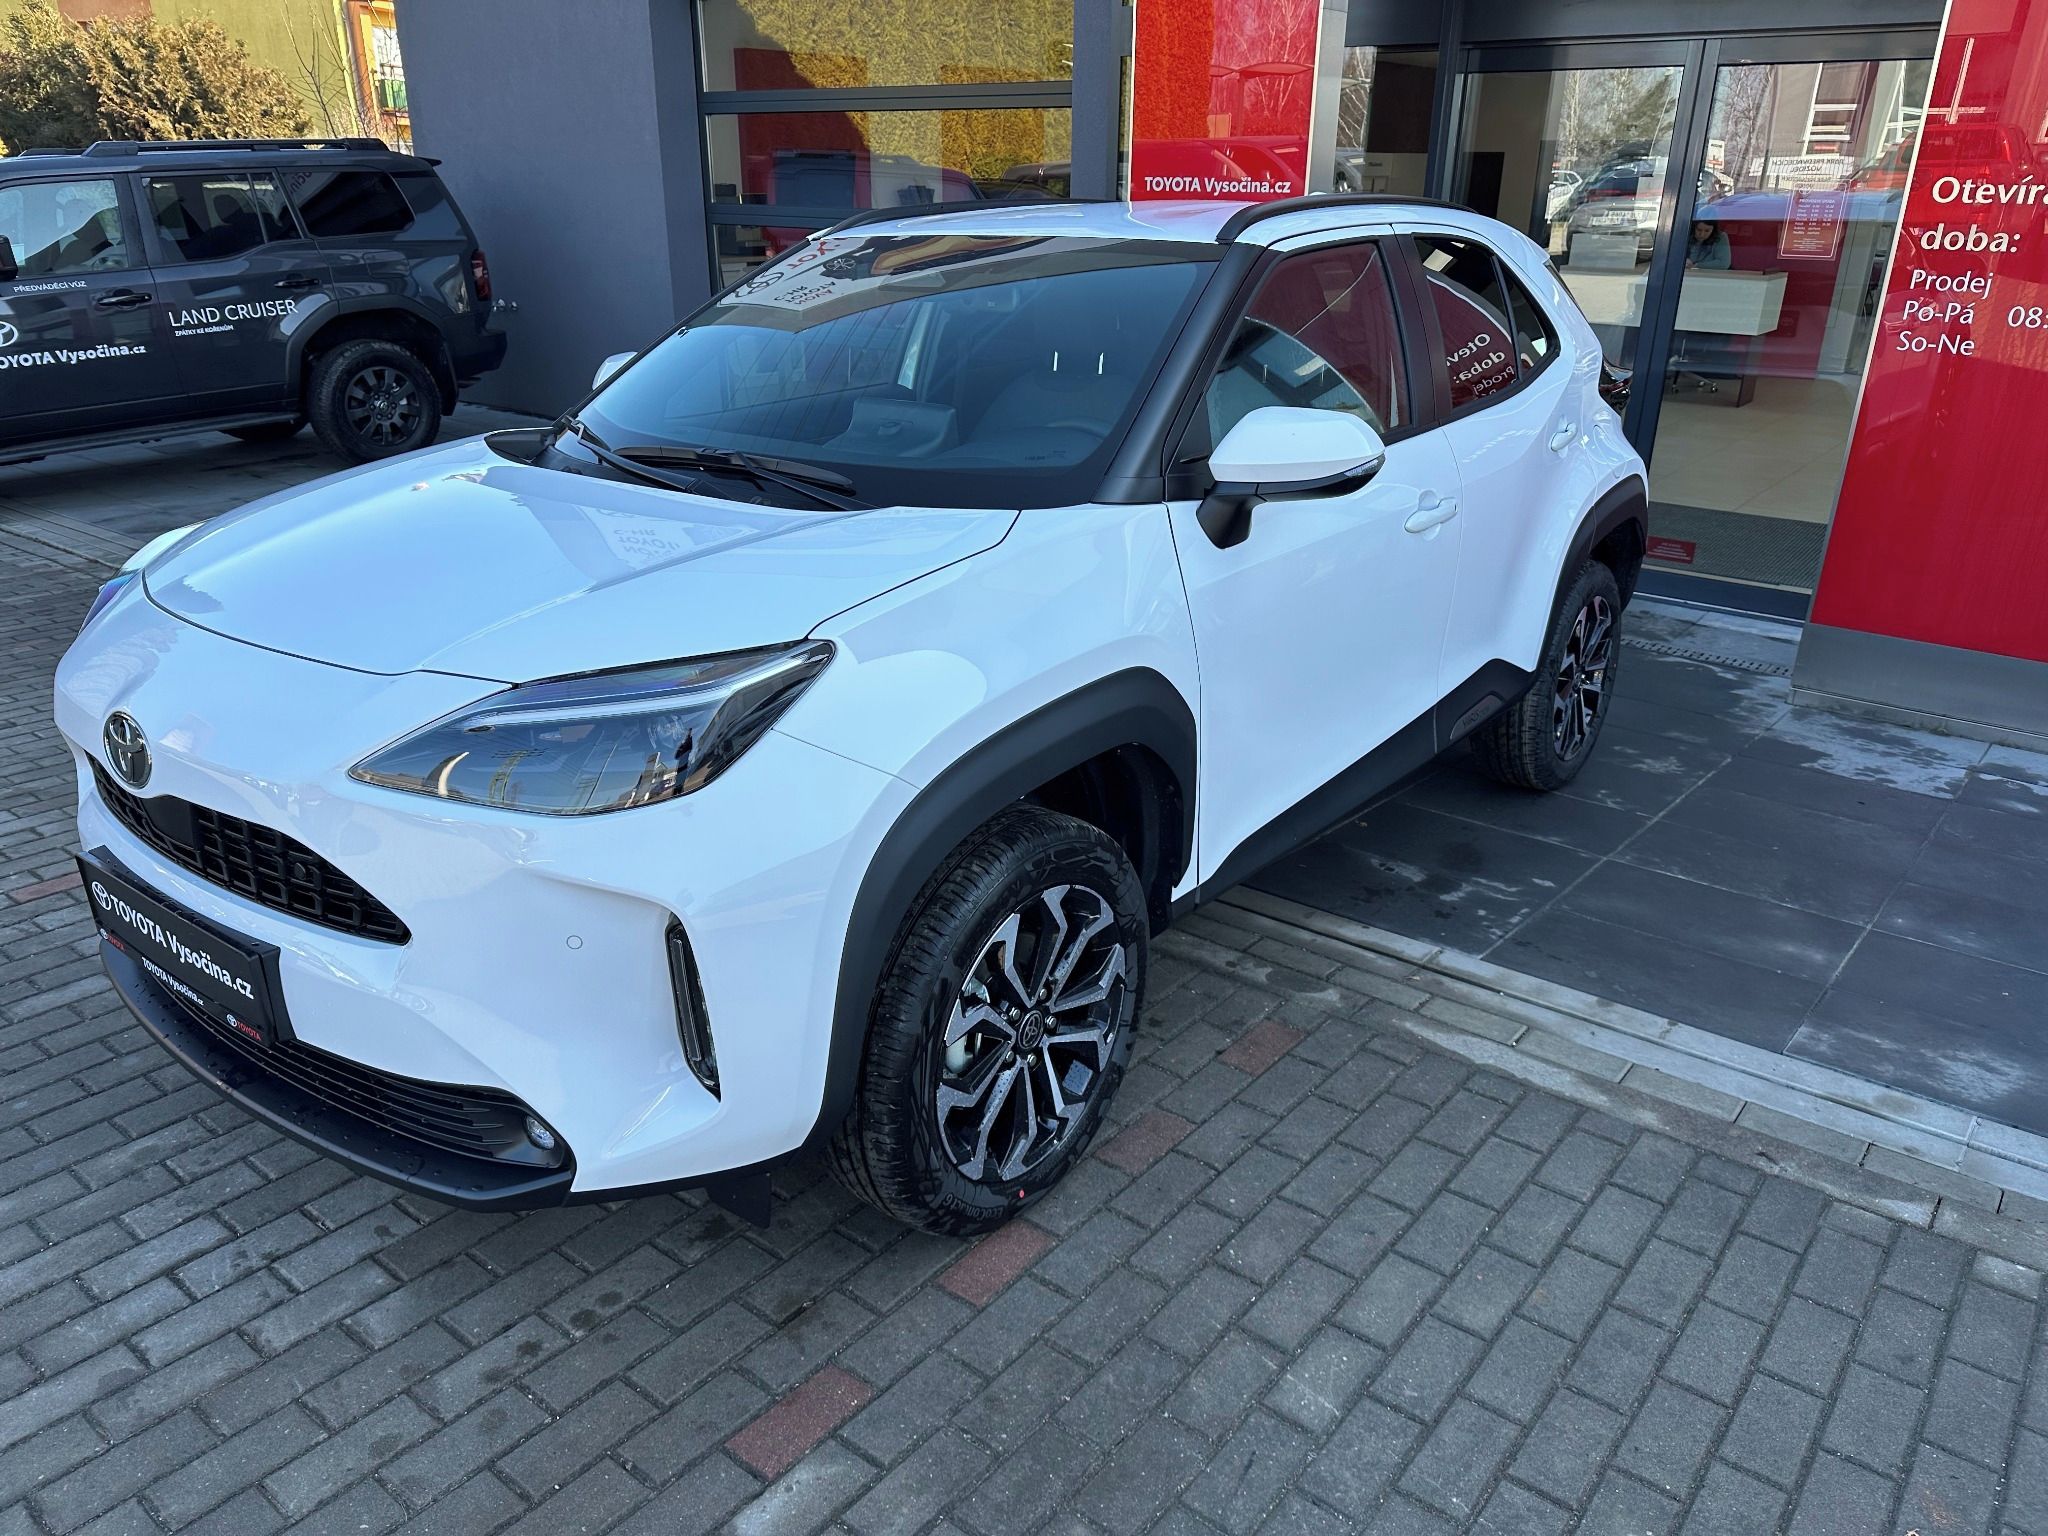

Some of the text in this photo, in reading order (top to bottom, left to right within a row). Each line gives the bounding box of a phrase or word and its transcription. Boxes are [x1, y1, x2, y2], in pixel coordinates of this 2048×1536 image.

[1145, 176, 1291, 196] TOYOTA Vysočina.cz
[1932, 174, 2048, 205] Otevír
[1920, 222, 2021, 253] doba:
[69, 280, 87, 288] VŮZ
[1909, 269, 1994, 300] Prodej
[168, 299, 299, 327] LAND CRUISER
[1902, 300, 1976, 325] Po-Pá
[0, 344, 147, 370] OYOTA Vysočina.cz
[1896, 331, 1975, 356] So-Ne
[110, 894, 254, 1000] TOYOTA Vysočina.cz
[141, 956, 204, 1007] TOYOTA Vysočina.cz
[236, 1020, 262, 1041] TOYOTA
